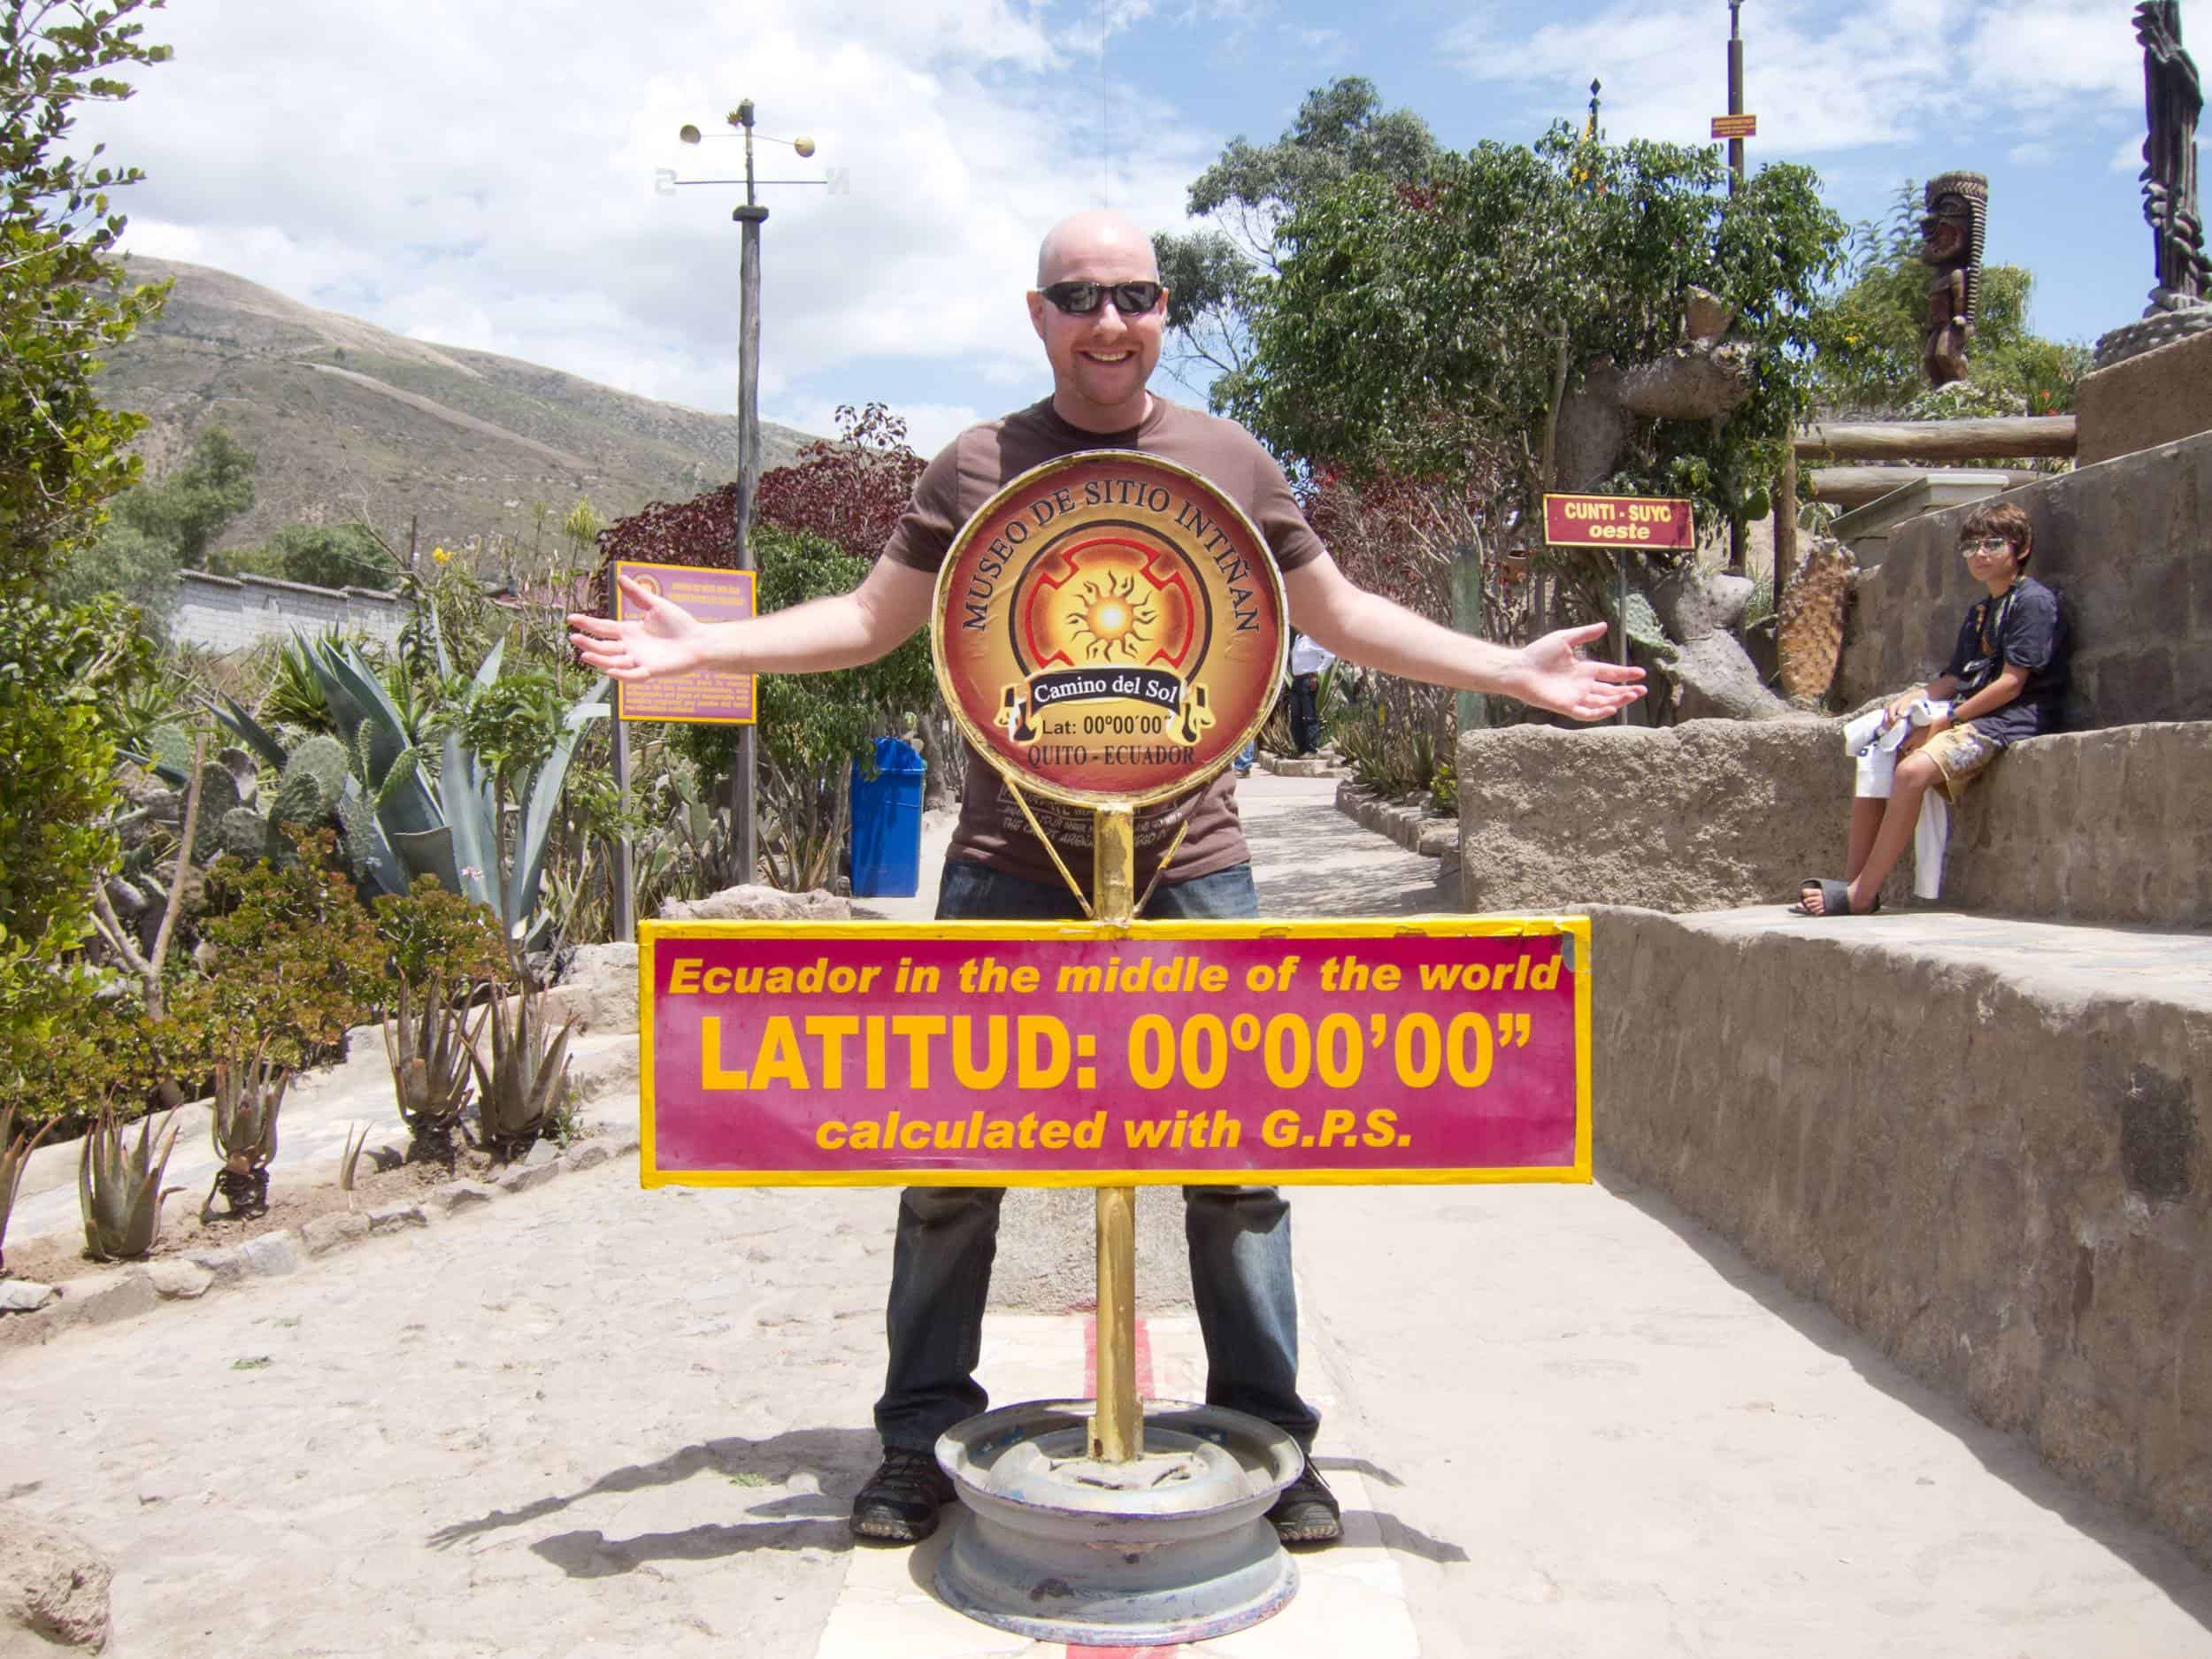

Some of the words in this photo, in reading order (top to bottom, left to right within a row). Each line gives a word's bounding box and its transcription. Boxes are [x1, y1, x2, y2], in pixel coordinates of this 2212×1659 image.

[1565, 503, 1616, 519] CUNTI
[1588, 524, 1650, 540] oeste
[963, 520, 1028, 631] MUSEO
[1029, 488, 1076, 526] DE
[1084, 480, 1170, 512] SITIO
[1174, 500, 1260, 632] INTIÑAN
[1034, 676, 1106, 703] Camino
[1112, 675, 1141, 695] del
[1146, 680, 1178, 703] Sol
[1042, 719, 1077, 734] Lat:
[1027, 745, 1087, 769] QUITO
[1105, 746, 1194, 766] ECUADOR
[669, 958, 880, 994] Ecuador
[895, 957, 940, 993] in
[959, 957, 1040, 993] the
[1056, 956, 1229, 992] middle
[1246, 956, 1301, 992] of
[1319, 956, 1402, 990] the
[1420, 956, 1560, 990] world
[701, 1015, 1097, 1090] LATITUD:
[815, 1110, 1108, 1150] calculated
[1124, 1110, 1241, 1148] with
[1261, 1109, 1413, 1148] G.P.S.
